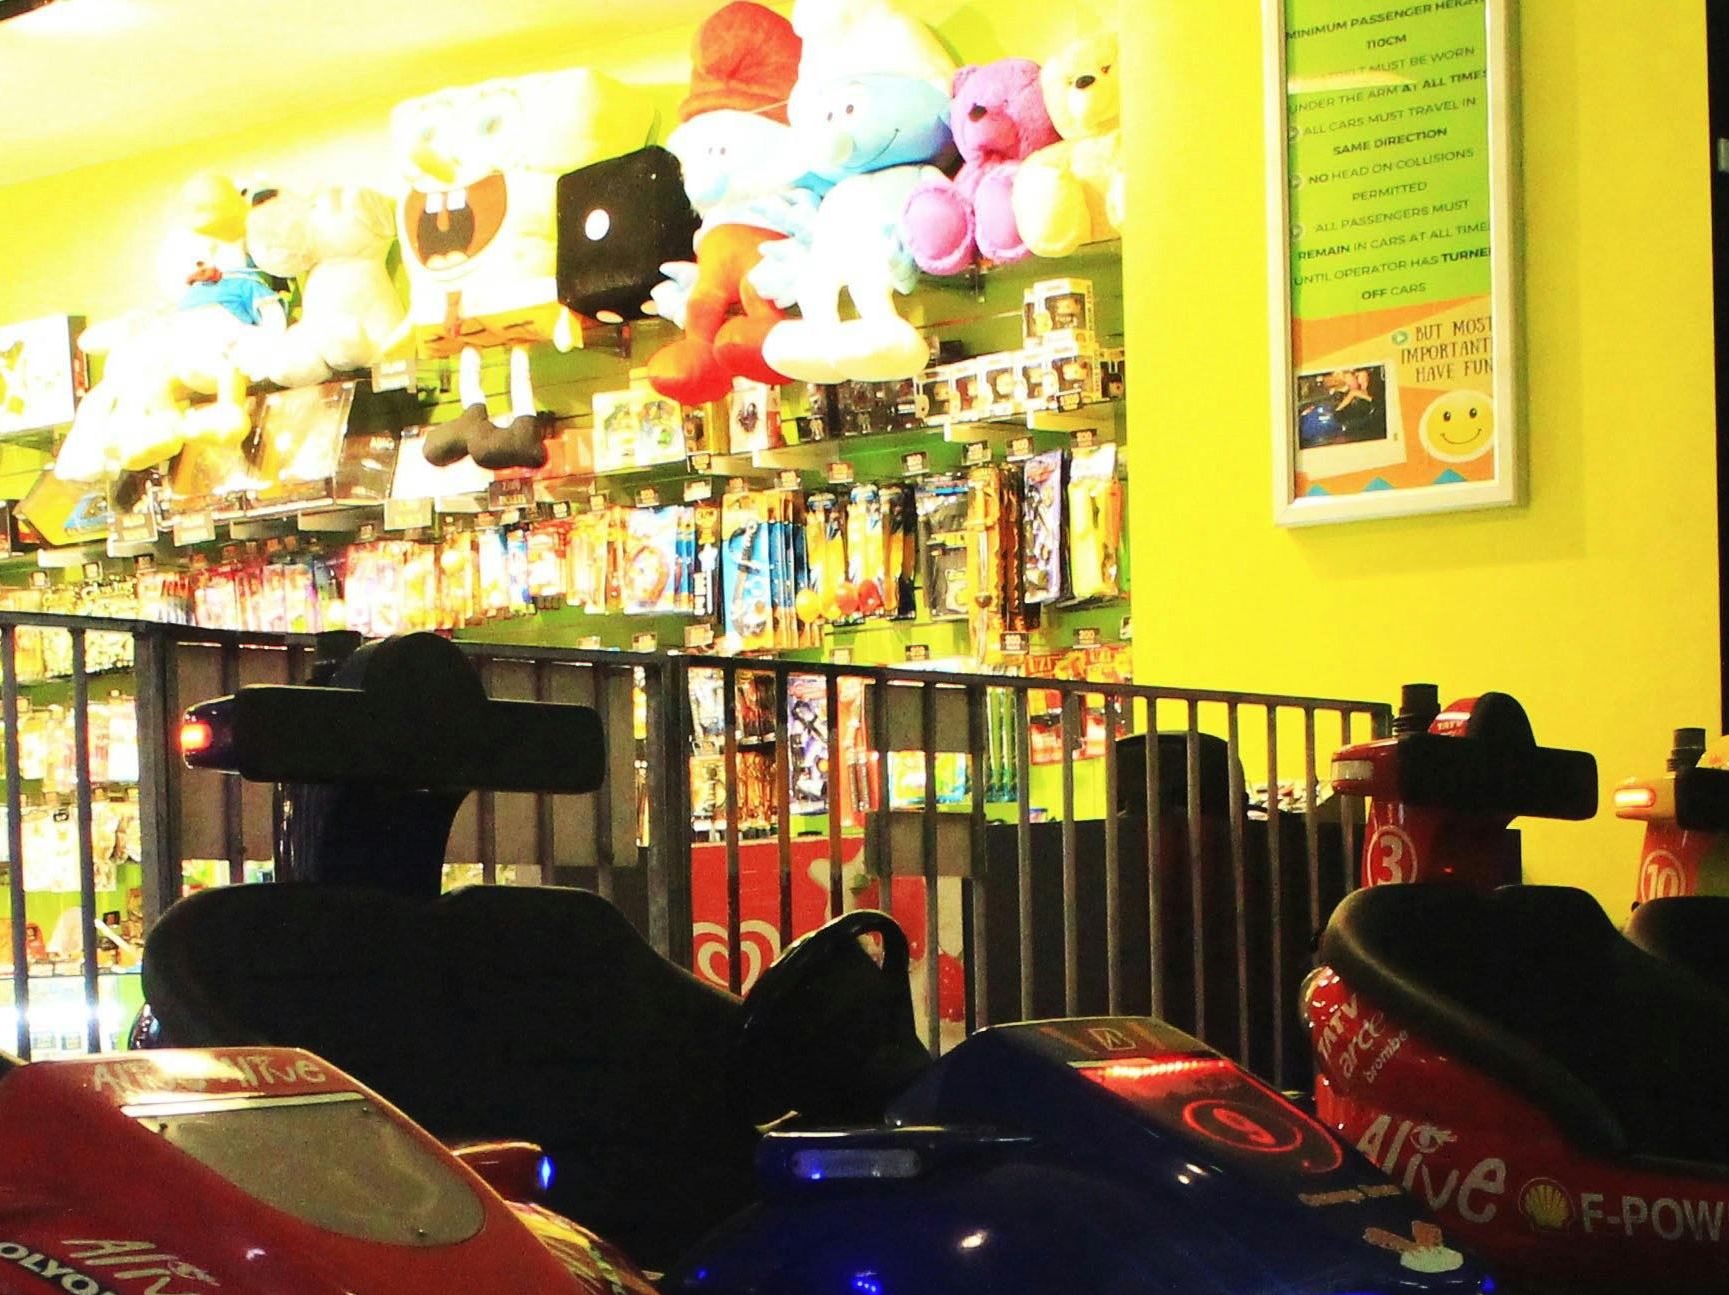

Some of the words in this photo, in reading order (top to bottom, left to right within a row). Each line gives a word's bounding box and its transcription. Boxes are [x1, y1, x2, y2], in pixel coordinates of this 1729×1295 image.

[1351, 4, 1433, 28] PASSENGER
[1366, 34, 1407, 50] 110CM
[1410, 55, 1427, 67] BE
[1431, 46, 1476, 63] WORN
[1339, 92, 1365, 105] THE
[1368, 86, 1398, 102] ARM
[1422, 77, 1447, 90] ALL
[1303, 122, 1326, 136] ALL
[1329, 117, 1364, 132] CARS
[1368, 109, 1405, 125] MUST
[1408, 101, 1460, 118] TRAVEL
[1462, 96, 1477, 109] IN
[1332, 141, 1370, 156] SAME
[1374, 127, 1448, 148] DIRECTION
[1308, 173, 1329, 185] NO
[1331, 167, 1370, 182] HEAD
[1372, 162, 1393, 174] ON
[1396, 147, 1475, 169] COLLISIONS
[1351, 181, 1428, 201] PERMITTED
[1315, 219, 1337, 233] ALL
[1341, 207, 1429, 230] PASSENGERS
[1432, 199, 1469, 214] MUST
[1298, 244, 1351, 261] REMAIN
[1352, 240, 1368, 253] IN
[1370, 234, 1406, 250] CARS
[1409, 230, 1426, 244] AT
[1429, 226, 1453, 240] ALL
[1456, 221, 1491, 235] TIME
[1334, 260, 1407, 280] OPERATOR
[1410, 254, 1439, 270] HAS
[1441, 246, 1491, 263] TURNE
[1362, 287, 1387, 301] OFF
[1390, 282, 1427, 297] CARS
[1415, 323, 1443, 342] BUT
[1453, 316, 1492, 336] MOST
[1401, 337, 1492, 365] IMPORTANT
[1415, 364, 1455, 383] HAVE
[1377, 835, 1403, 885] 3
[1645, 863, 1679, 899] 10
[1357, 1114, 1506, 1223] Alive
